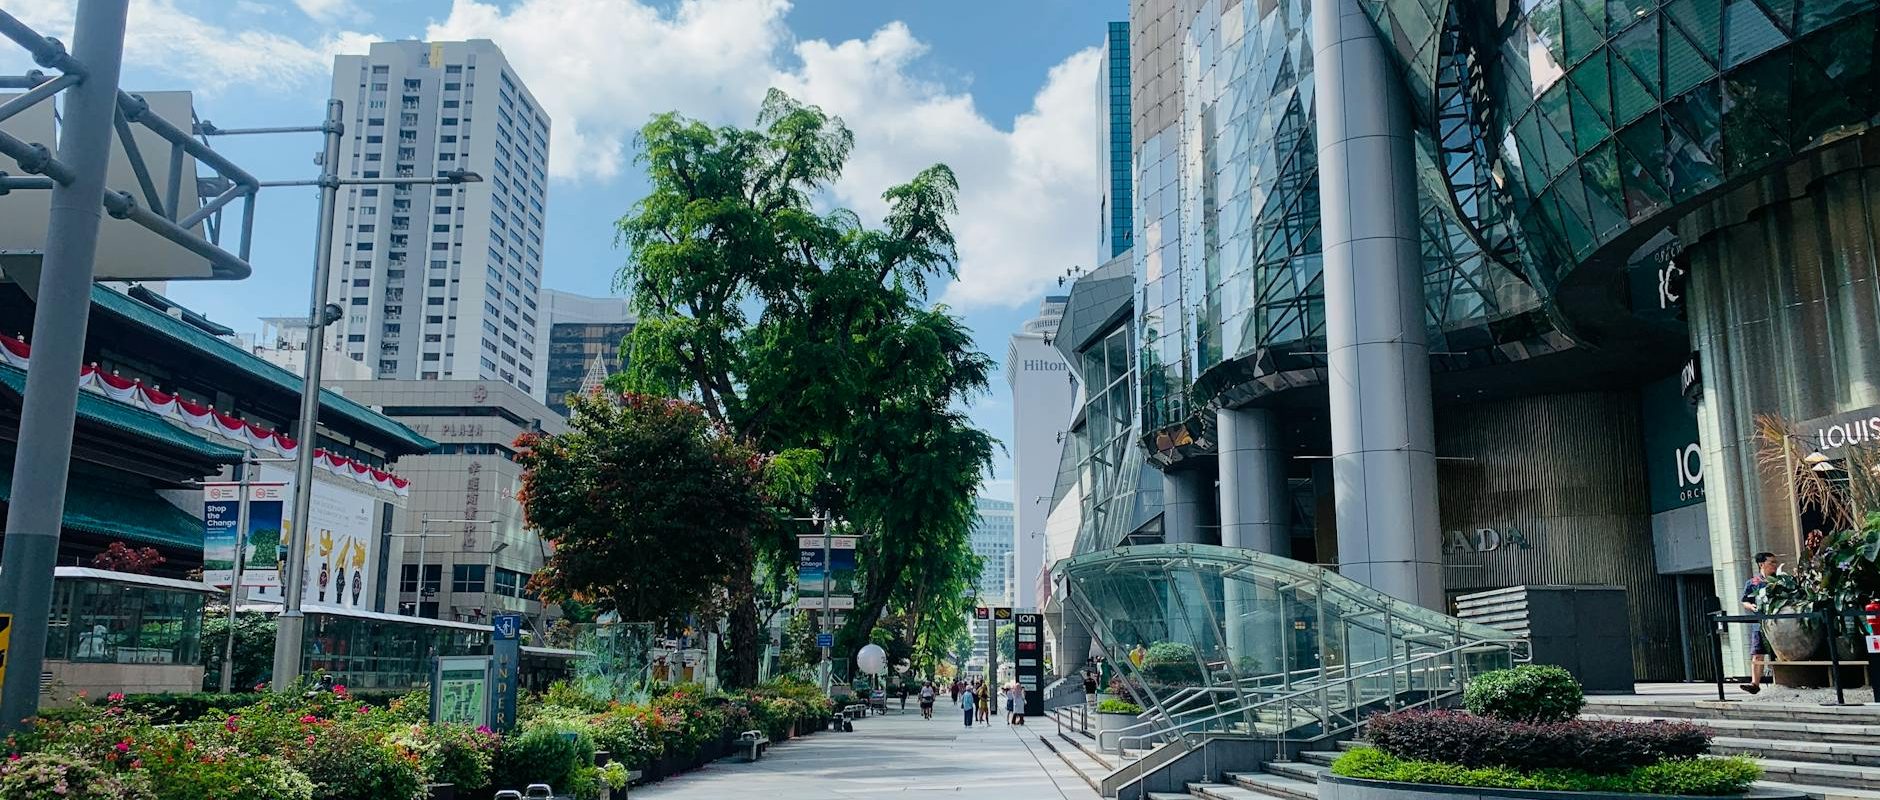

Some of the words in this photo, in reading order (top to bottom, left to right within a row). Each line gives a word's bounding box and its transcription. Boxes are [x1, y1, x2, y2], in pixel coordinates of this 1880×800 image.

[1024, 359, 1066, 371] Hilton
[441, 424, 482, 437] PLAZA
[1818, 416, 1880, 450] LOUIS
[207, 505, 227, 514] Shop
[207, 520, 237, 528] Change
[1440, 526, 1533, 555] ADA
[801, 551, 816, 559] Shop
[801, 561, 822, 569] Change
